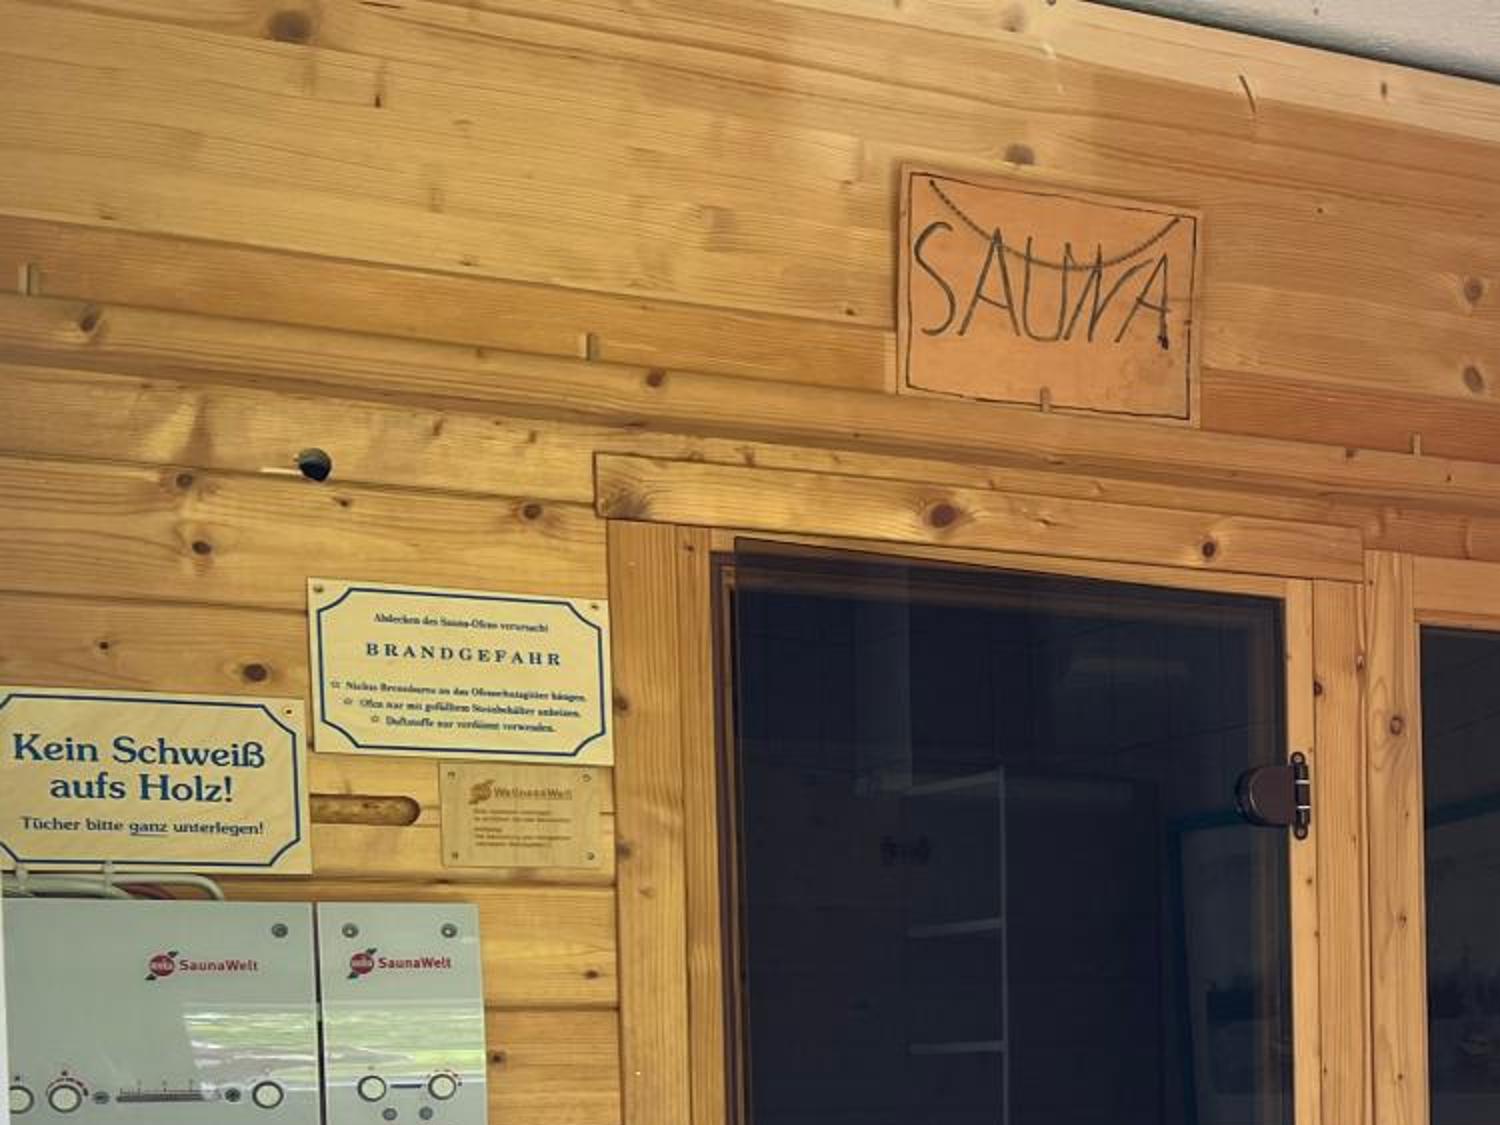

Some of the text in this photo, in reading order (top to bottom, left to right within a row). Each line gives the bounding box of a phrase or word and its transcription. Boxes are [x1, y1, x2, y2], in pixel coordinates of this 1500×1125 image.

[914, 221, 1172, 350] SAUNA
[365, 642, 561, 665] BRANDGEFAHR
[12, 733, 266, 768] Kein Schweiß
[50, 771, 233, 803] aufs Holz!
[21, 816, 265, 836] Tücher bitte ganz unterlegen!
[179, 959, 259, 971] SaunaWelt
[379, 956, 452, 969] SaunaWelt
